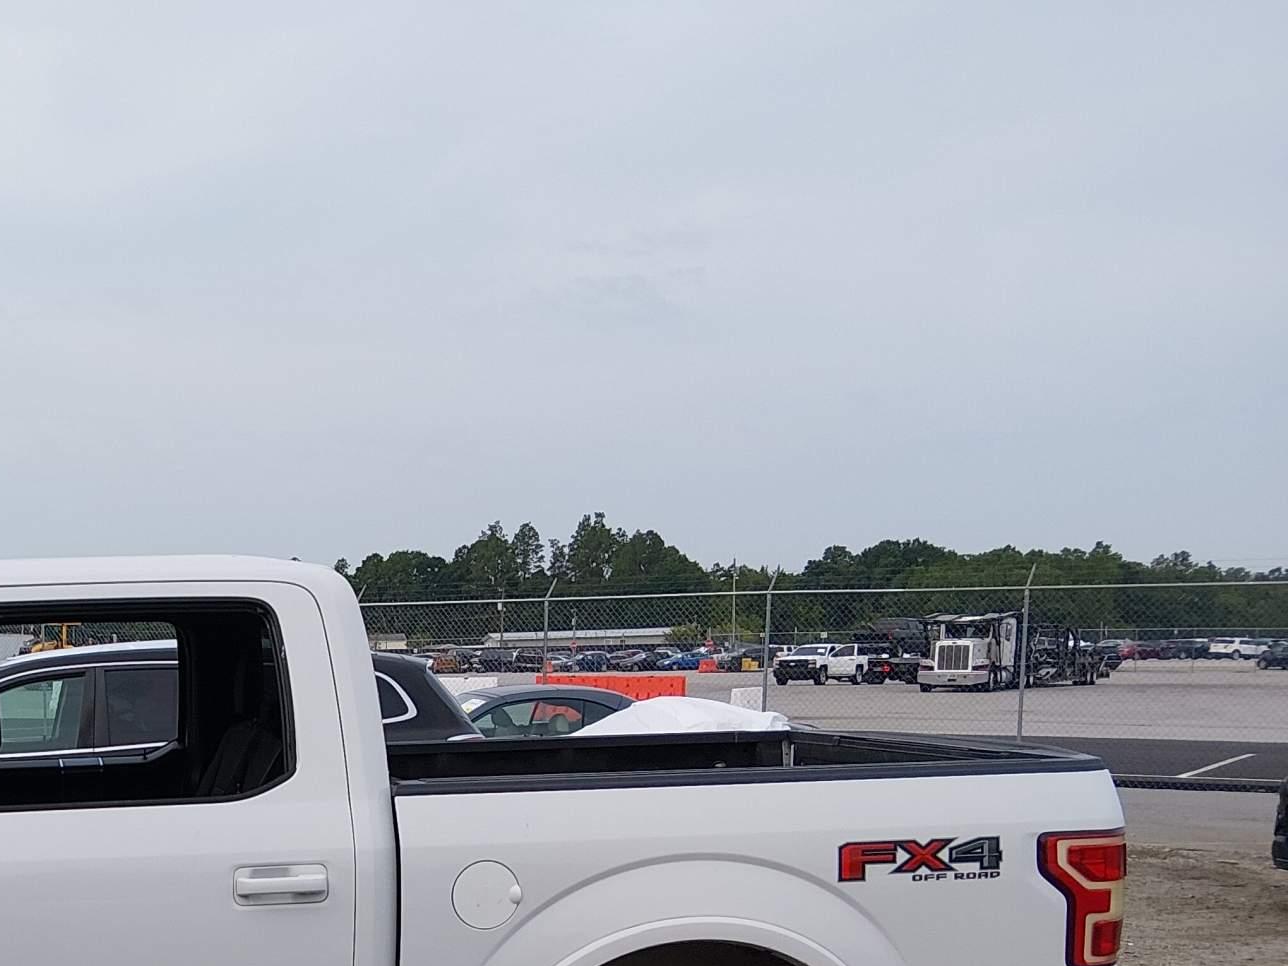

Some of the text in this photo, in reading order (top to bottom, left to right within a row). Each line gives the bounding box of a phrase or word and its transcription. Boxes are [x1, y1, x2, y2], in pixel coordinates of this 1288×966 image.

[838, 836, 1003, 882] FX4
[912, 871, 1001, 882] OFF ROAD
